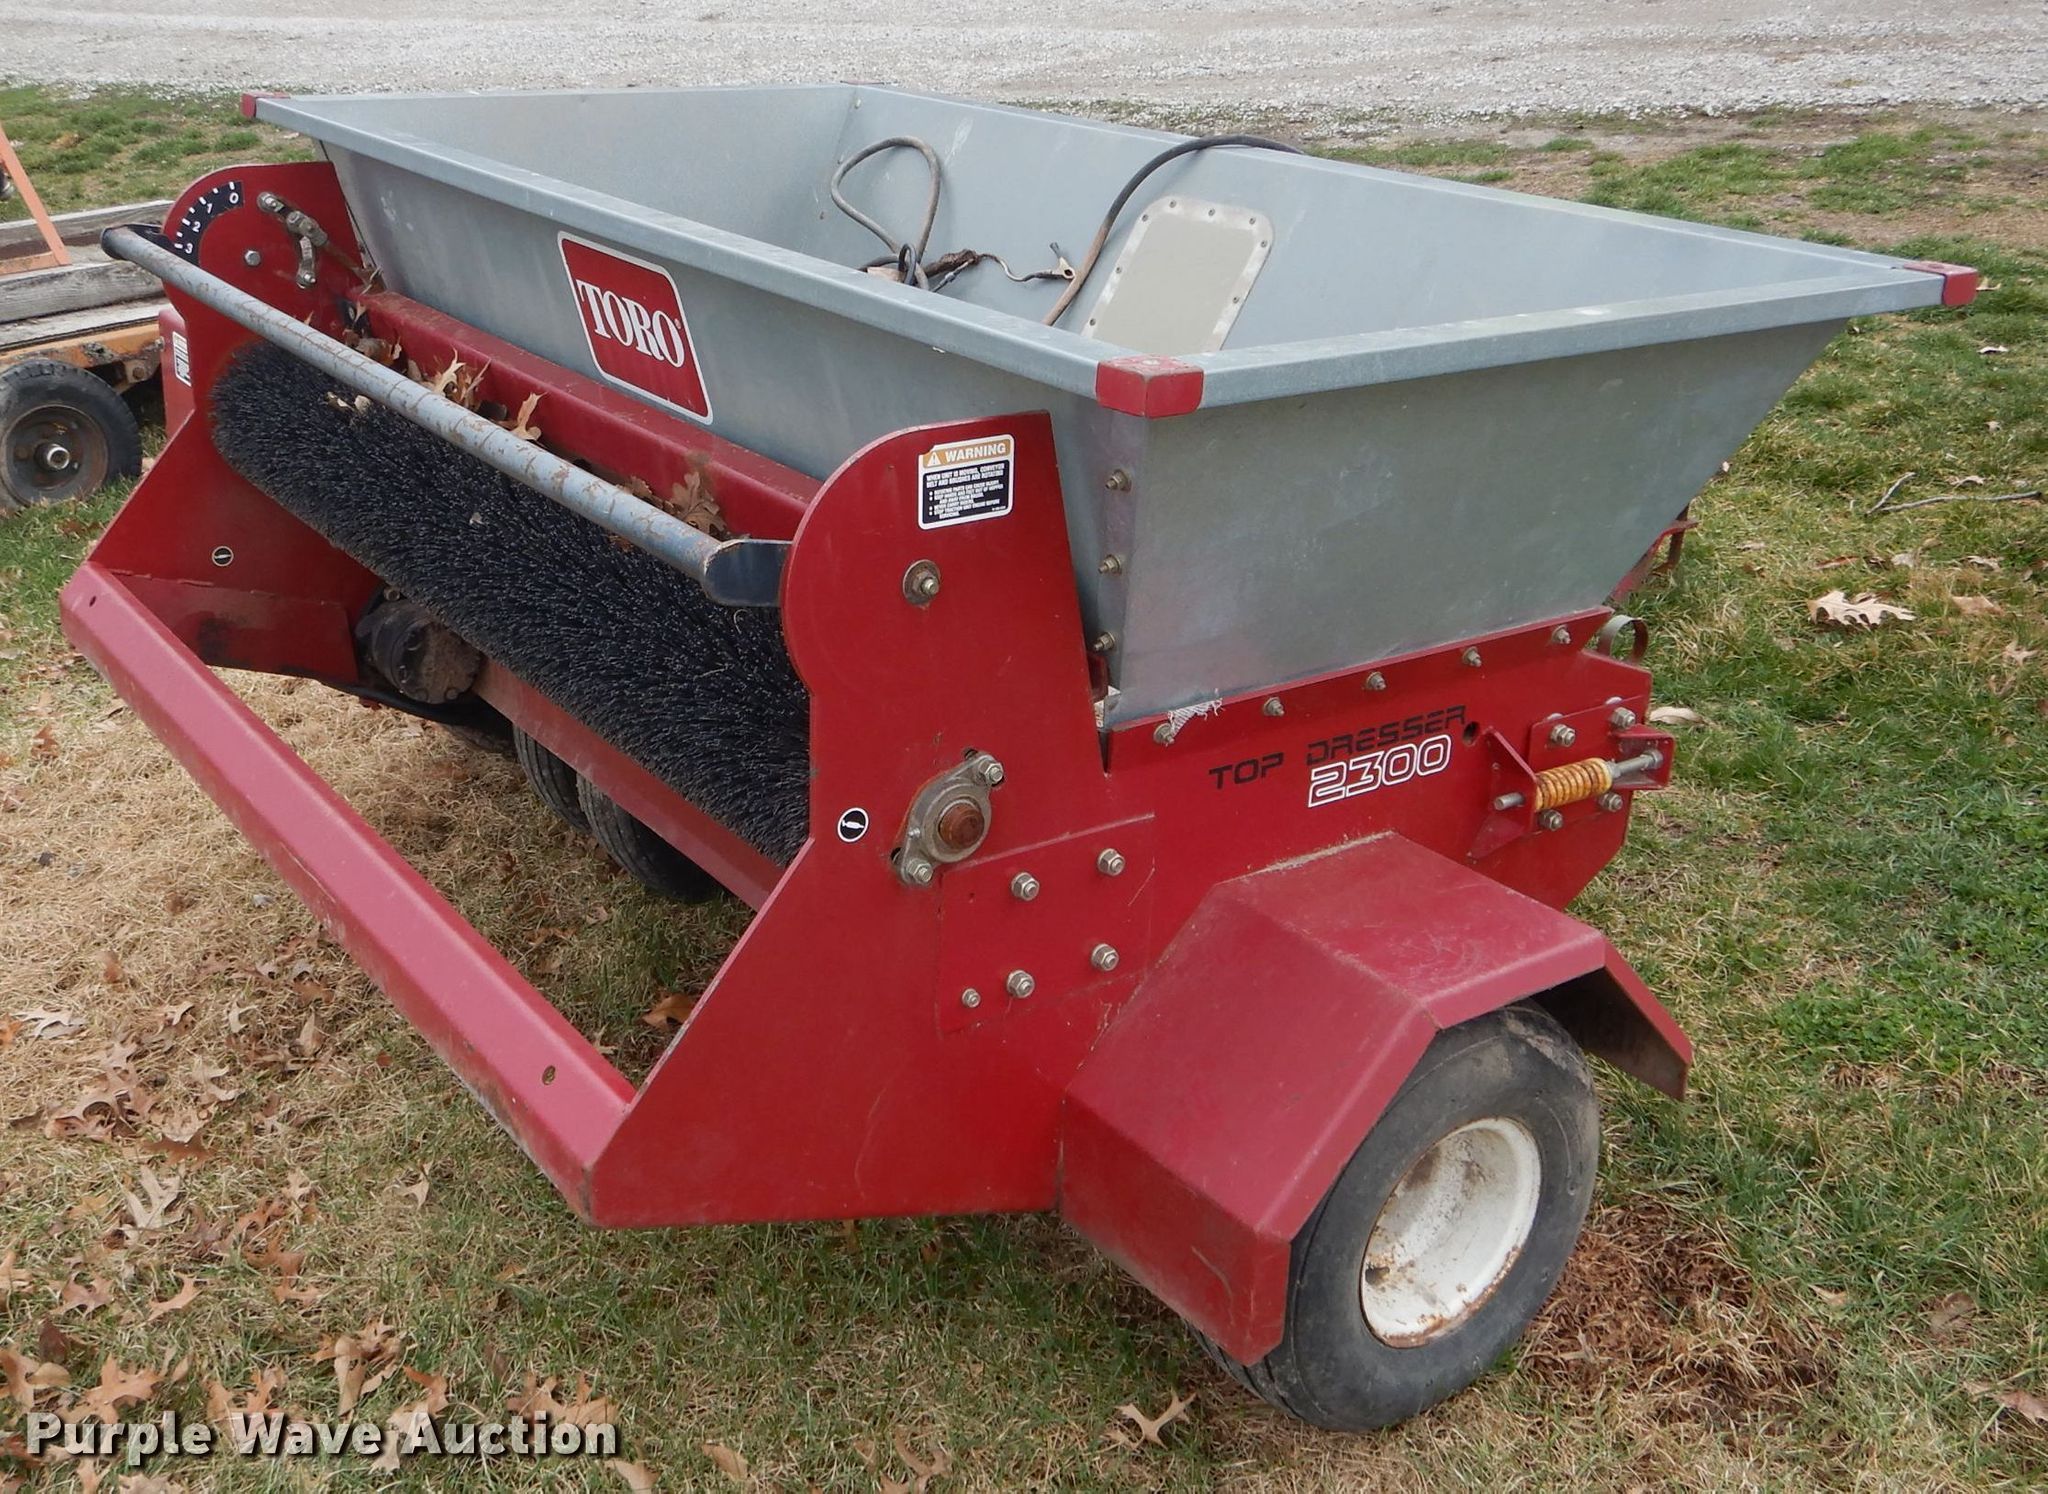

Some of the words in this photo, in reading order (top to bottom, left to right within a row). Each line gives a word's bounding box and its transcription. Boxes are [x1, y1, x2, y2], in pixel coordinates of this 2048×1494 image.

[229, 192, 239, 204] 0
[192, 221, 201, 233] 2
[185, 243, 193, 254] 3
[575, 279, 685, 367] TORO
[945, 443, 1006, 462] WARNING
[1209, 752, 1284, 790] TOP
[1306, 704, 1467, 766] DRESSER
[1308, 734, 1452, 808] 2300
